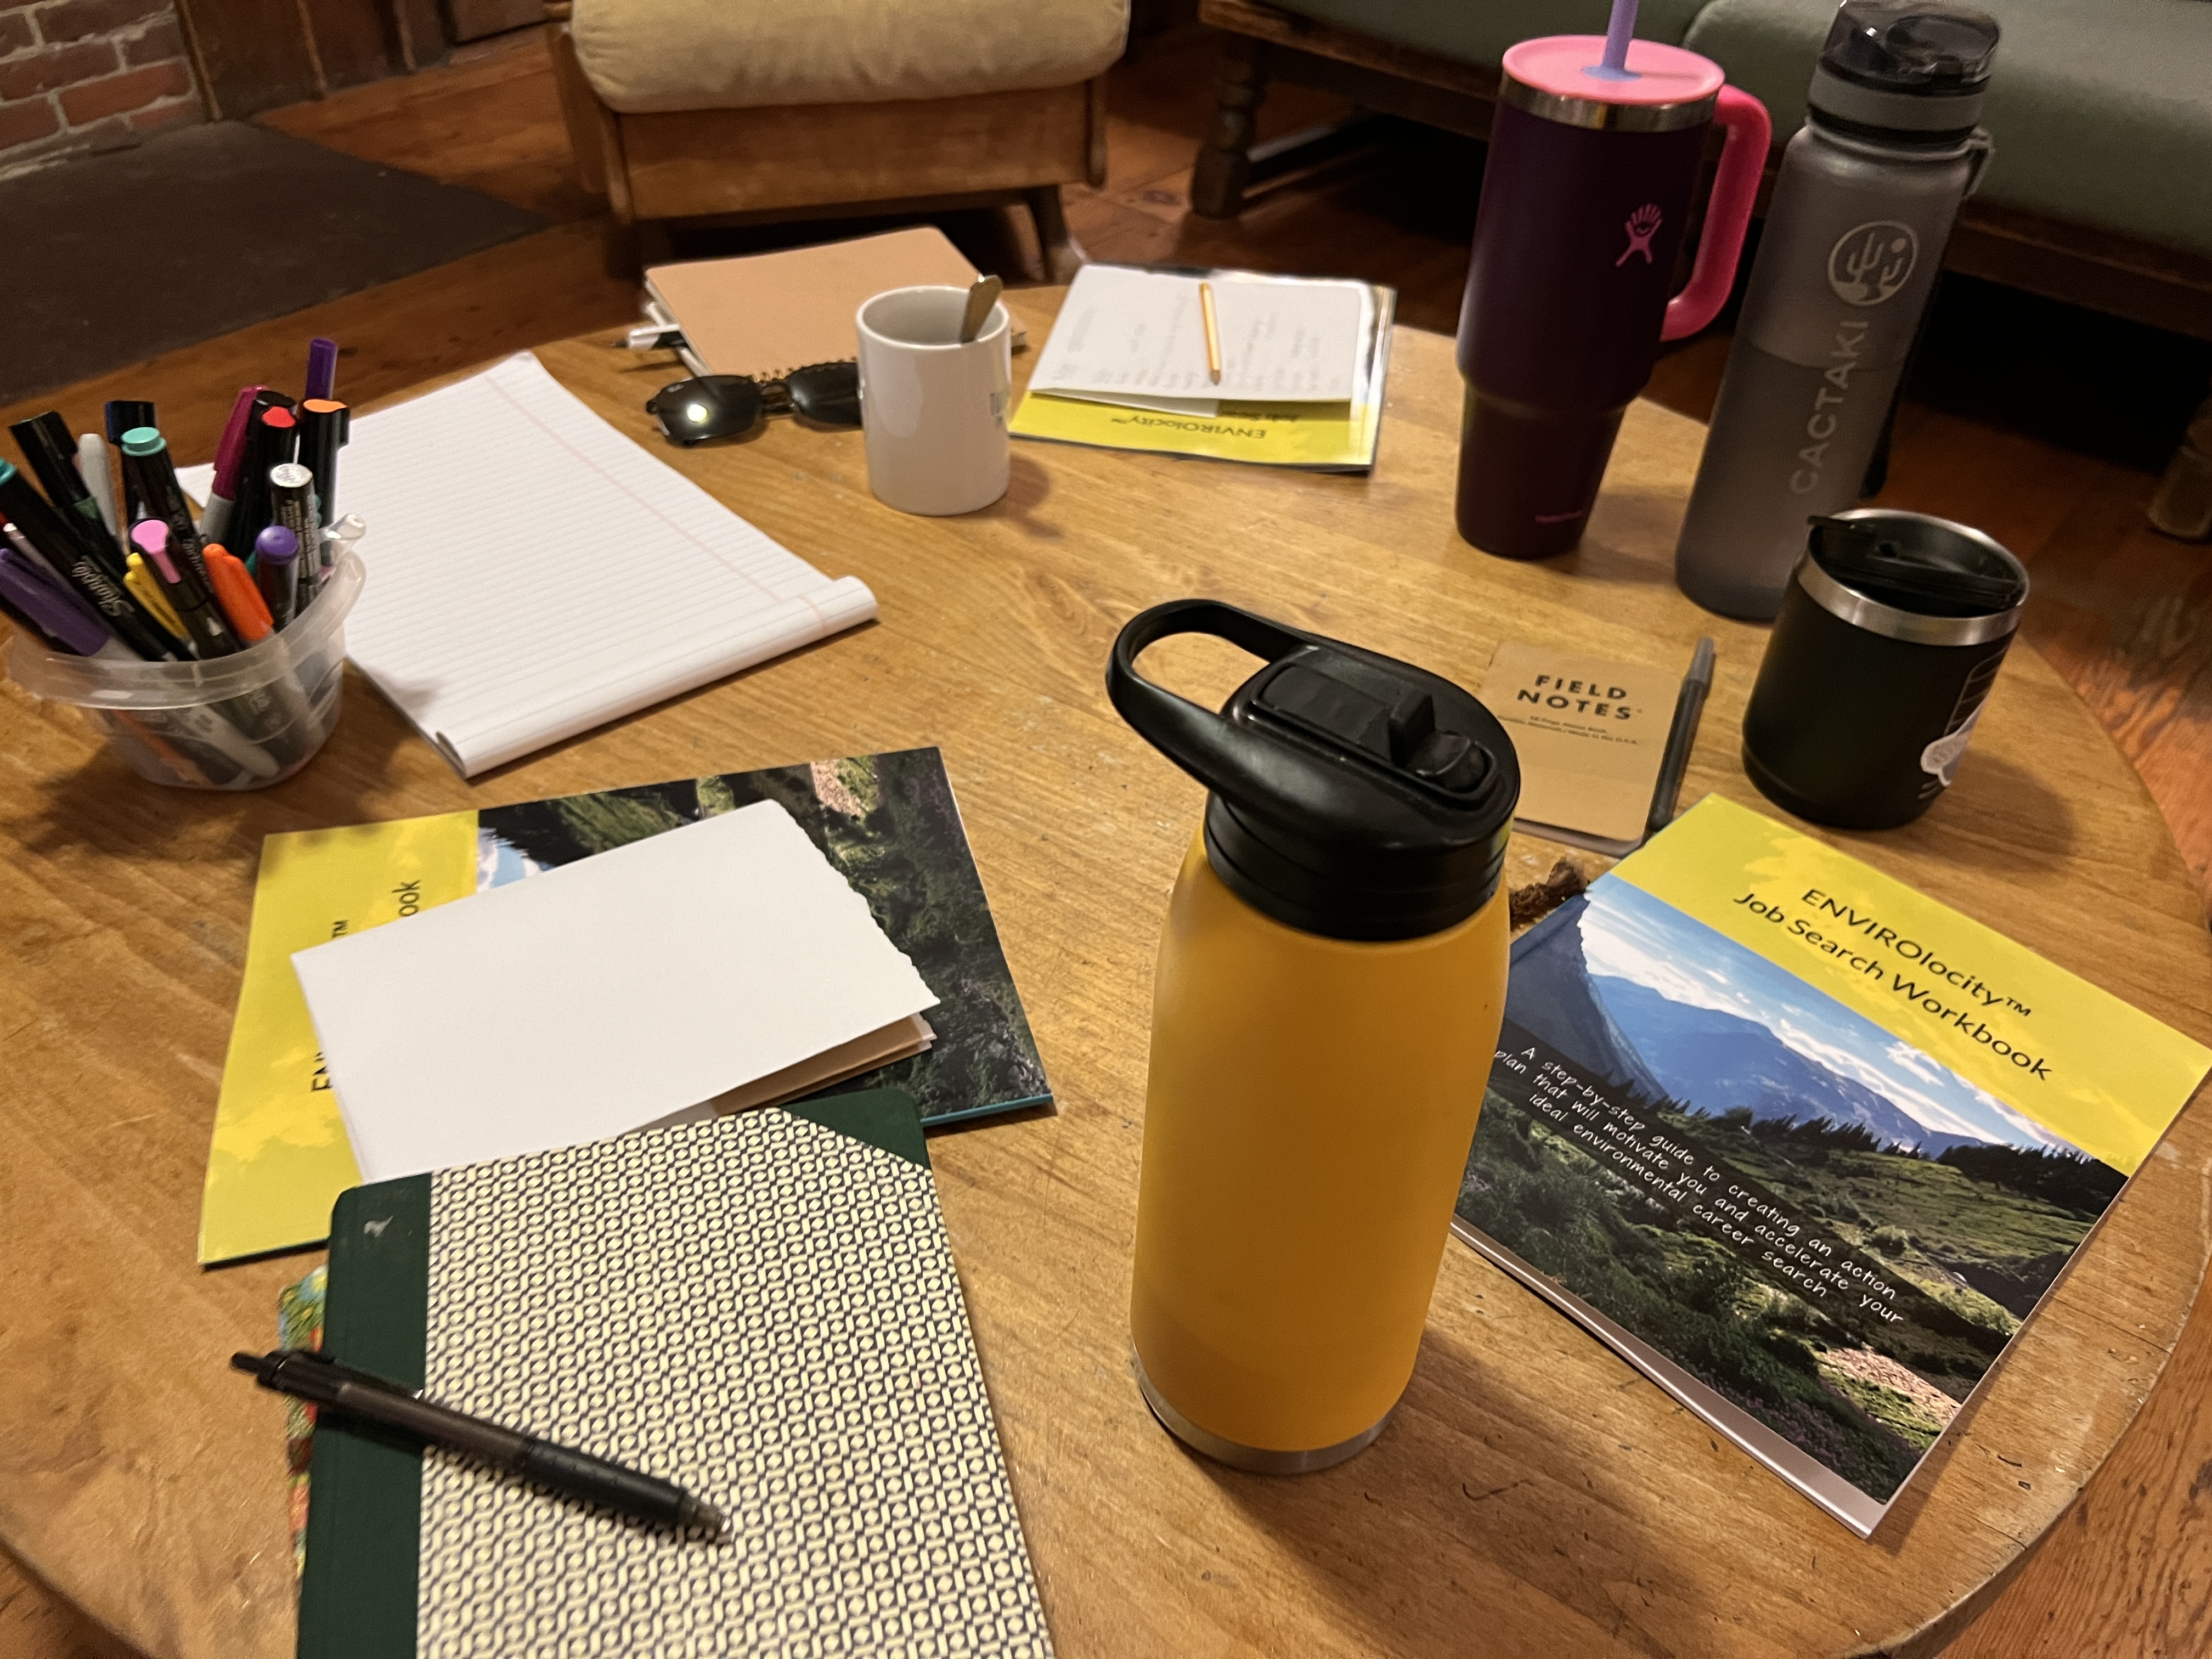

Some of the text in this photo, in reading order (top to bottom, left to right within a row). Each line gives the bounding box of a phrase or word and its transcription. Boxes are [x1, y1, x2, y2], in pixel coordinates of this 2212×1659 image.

[1789, 321, 1869, 493] CACTAKI
[1516, 689, 1630, 720] NOTES
[1535, 674, 1627, 700] FIELD
[1734, 893, 2052, 1081] Job Search Workbook
[1494, 1049, 1904, 1324] plan that will motivate you and accelerate your
[1521, 1047, 1896, 1300] A step-by-step guide to creating an action
[1528, 1092, 1827, 1298] ideal environmental career search
